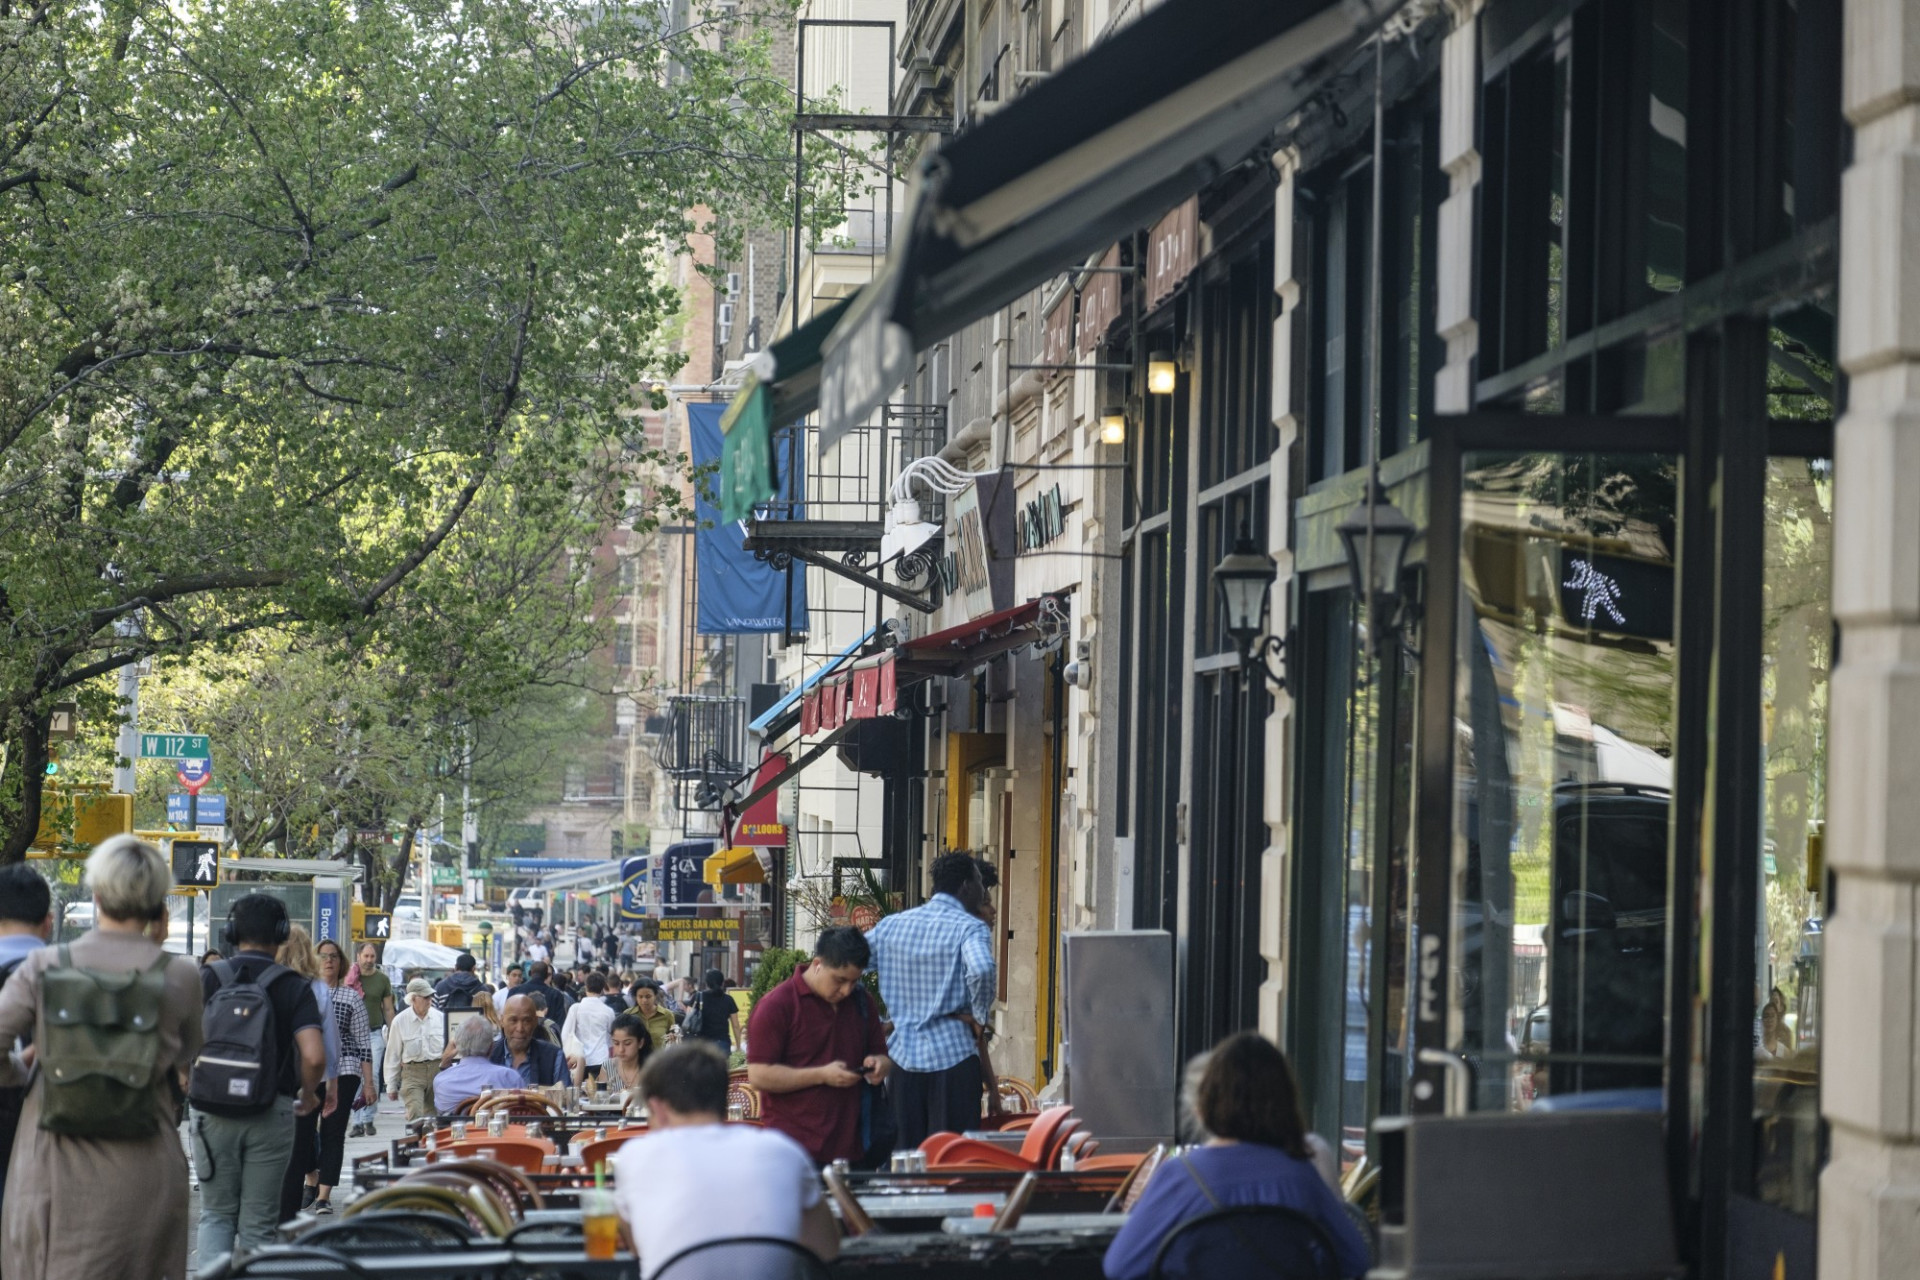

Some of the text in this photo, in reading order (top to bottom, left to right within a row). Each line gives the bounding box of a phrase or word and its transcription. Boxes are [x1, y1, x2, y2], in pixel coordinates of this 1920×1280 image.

[146, 737, 202, 756] W 112 ST
[168, 797, 181, 807] M4
[168, 810, 188, 821] M104
[659, 919, 691, 929] HEIGHTS
[692, 919, 708, 929] BAR
[709, 919, 723, 929] AND
[658, 930, 674, 940] DINE
[677, 930, 702, 940] ABOVE
[716, 930, 730, 940] ALL
[1420, 934, 1440, 1021] PULL
